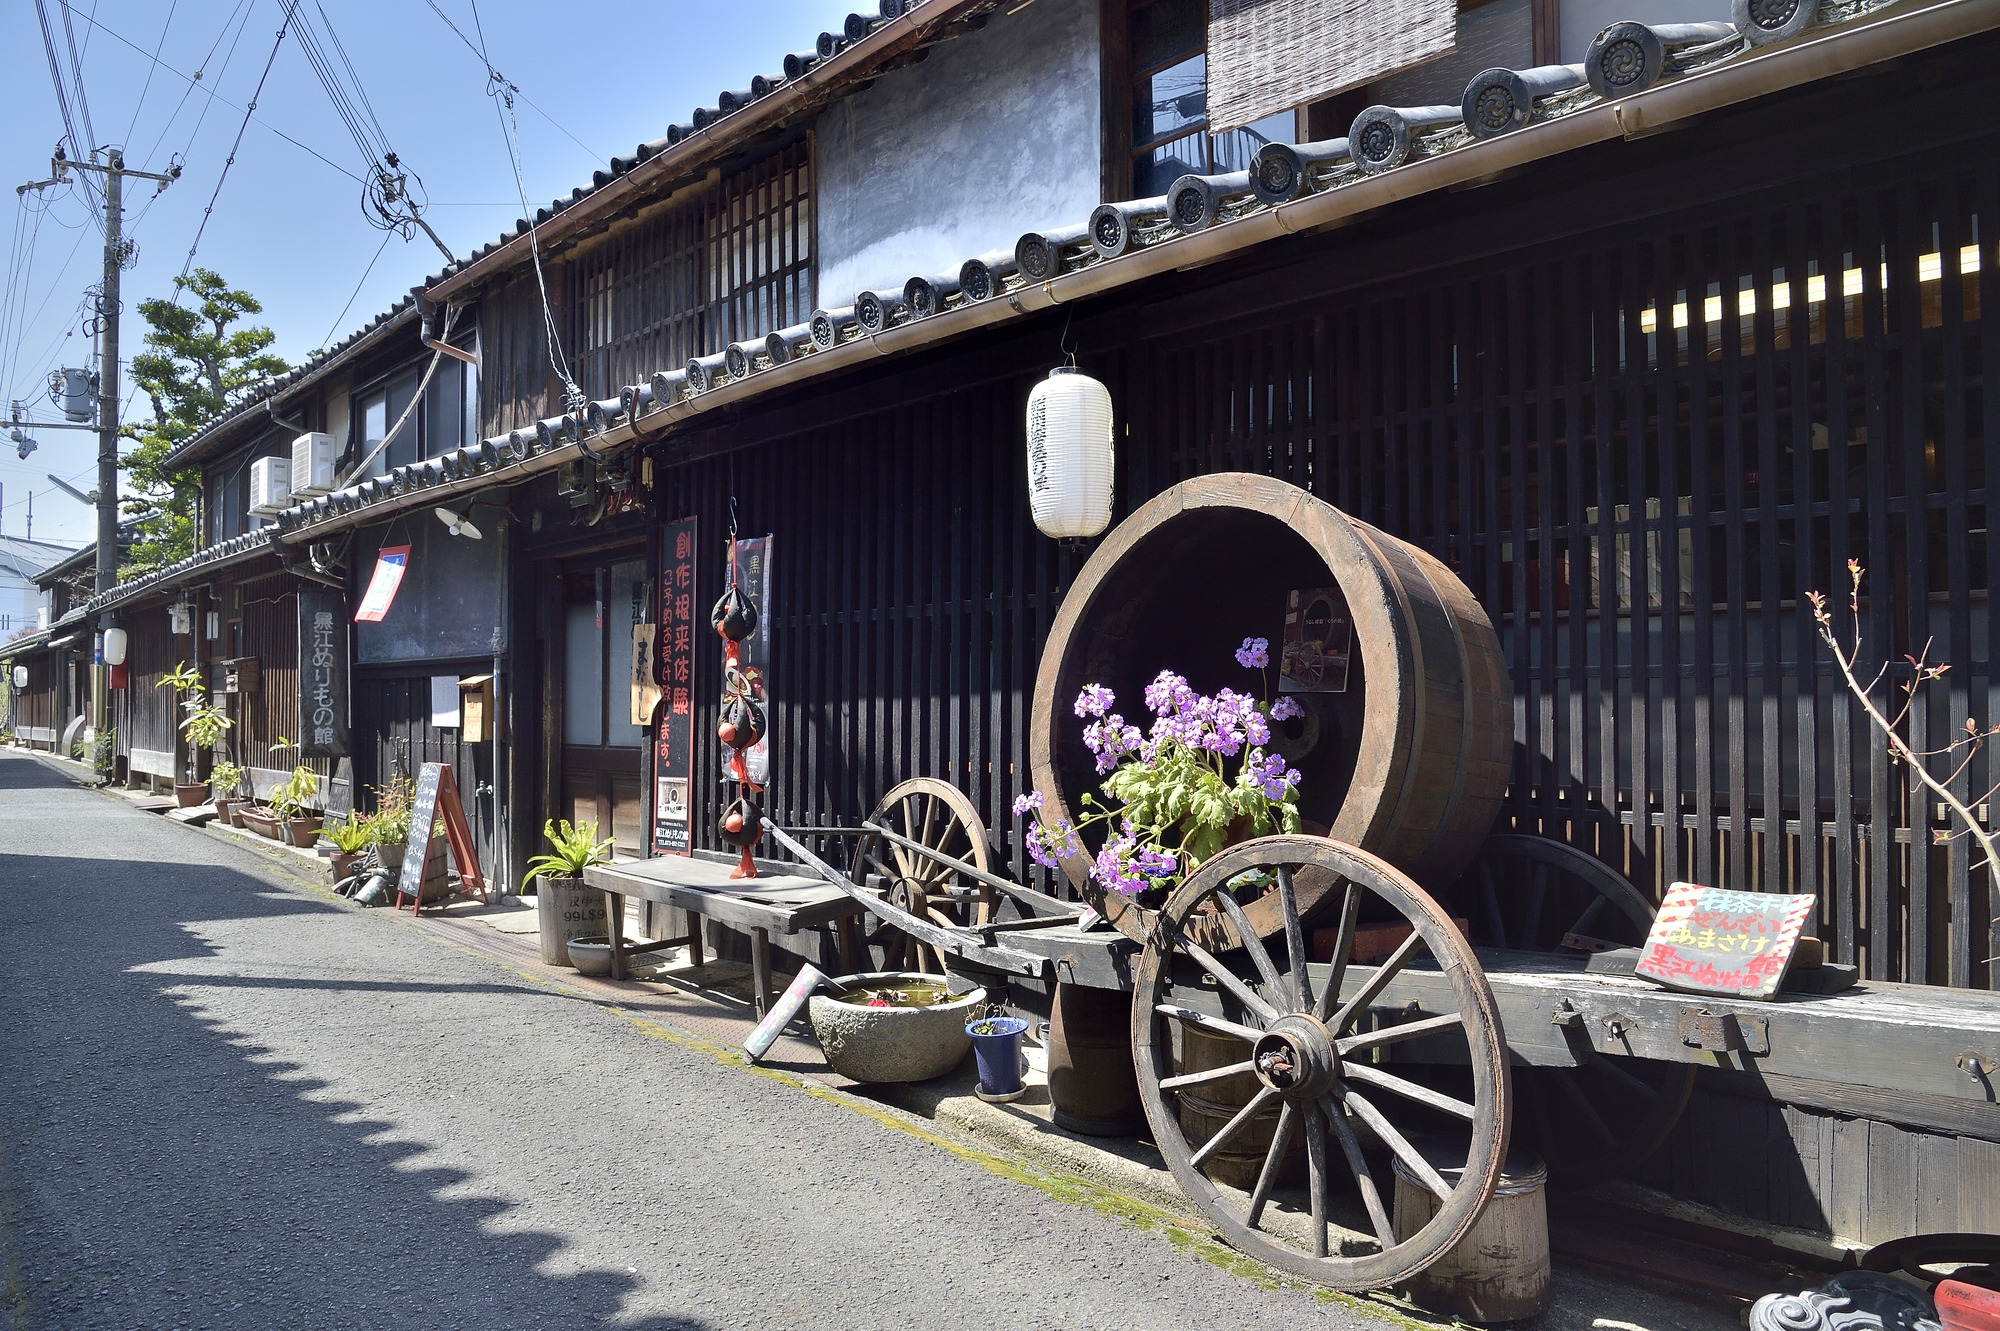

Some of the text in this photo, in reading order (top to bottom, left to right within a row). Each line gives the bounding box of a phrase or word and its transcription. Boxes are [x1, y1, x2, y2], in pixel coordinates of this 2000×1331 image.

[312, 611, 334, 745] 黒江ぬりもの館
[1688, 911, 1781, 934] ぜんざい
[1668, 925, 1772, 955] あまざけ
